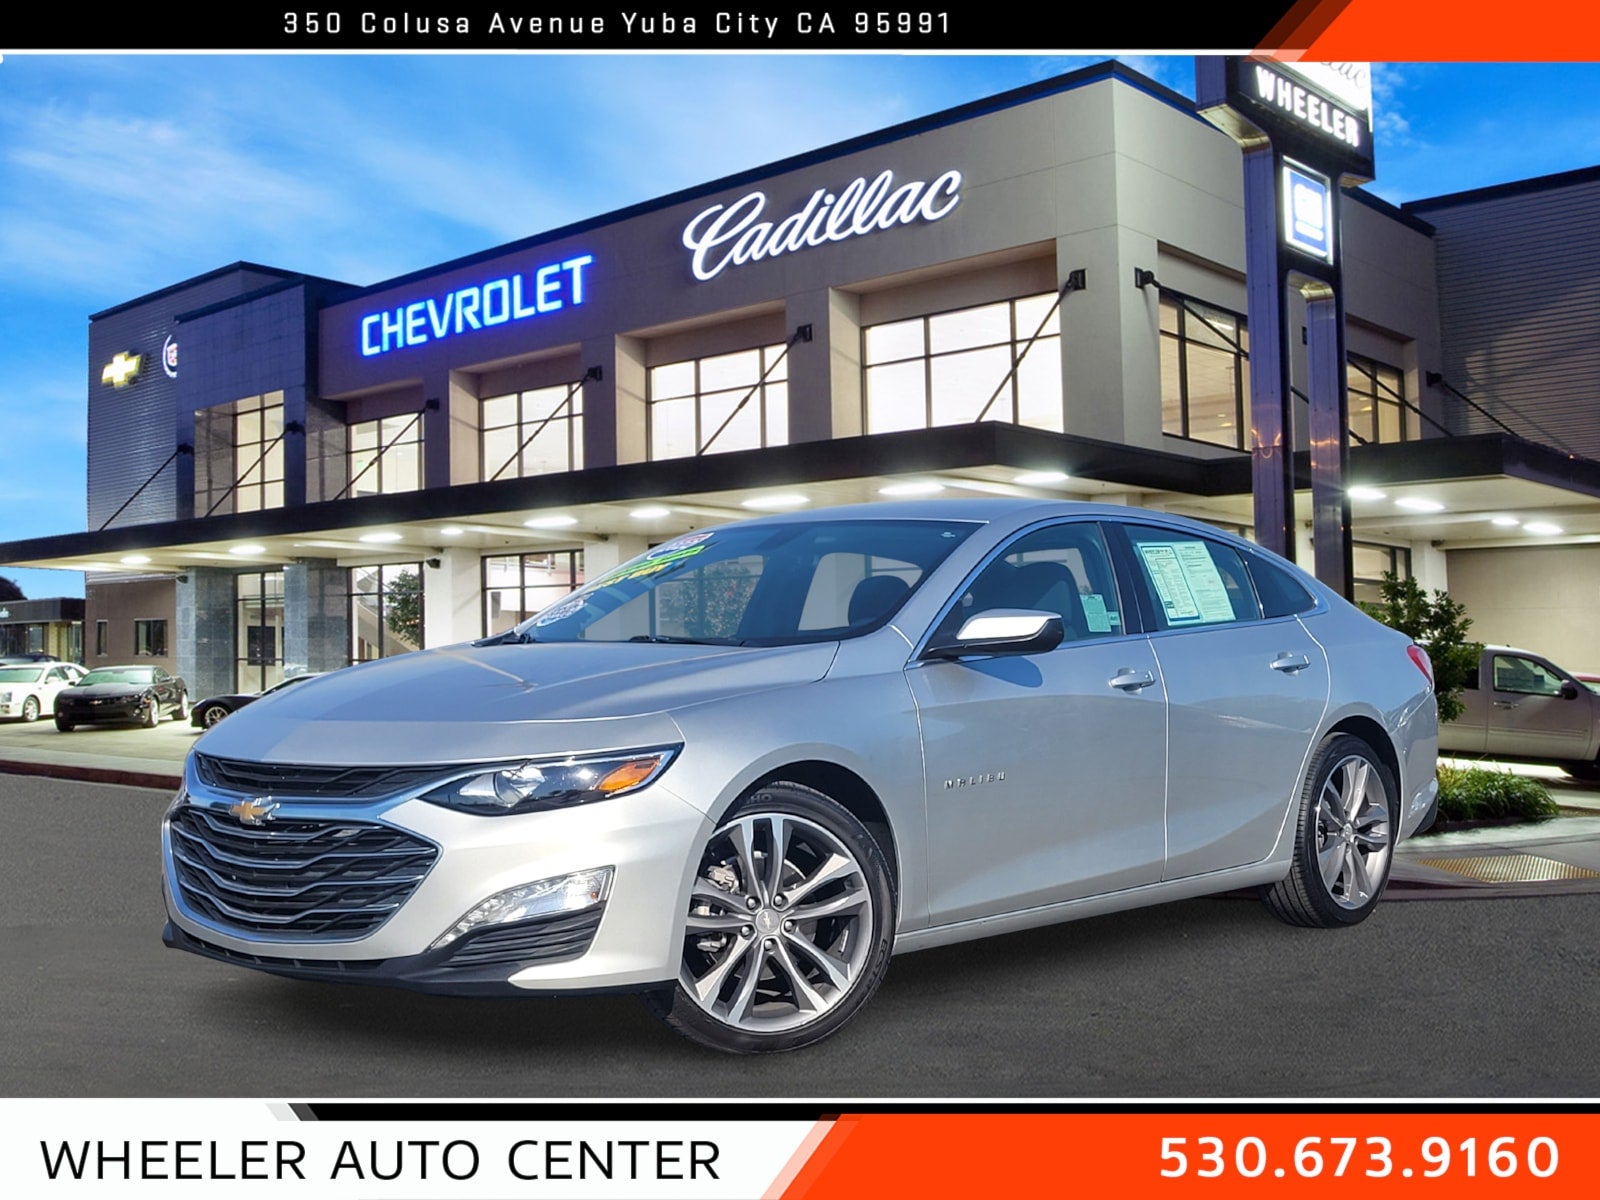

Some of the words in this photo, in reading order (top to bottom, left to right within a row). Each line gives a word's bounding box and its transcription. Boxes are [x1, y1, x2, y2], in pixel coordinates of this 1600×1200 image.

[1255, 65, 1360, 147] WHEELER
[682, 168, 963, 281] Cadillac
[360, 255, 595, 357] CHEVROLET
[944, 771, 1006, 790] MALIBU
